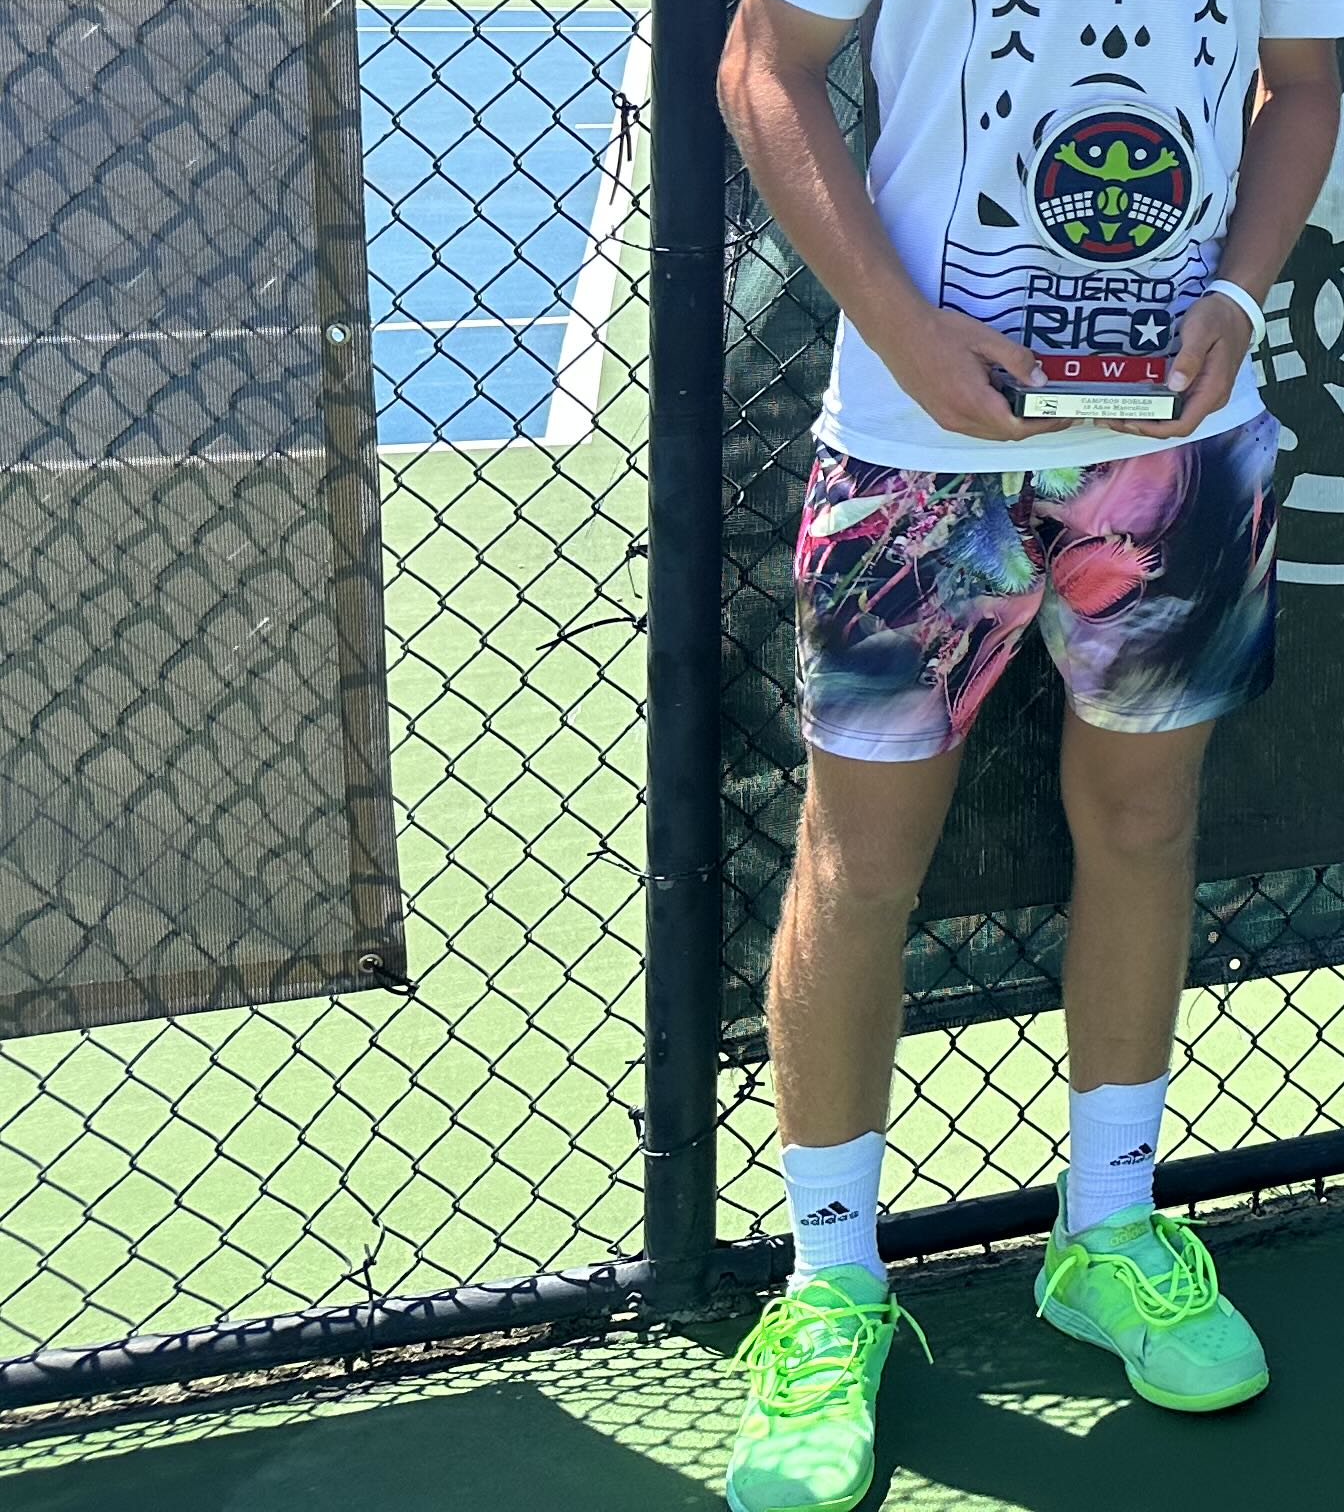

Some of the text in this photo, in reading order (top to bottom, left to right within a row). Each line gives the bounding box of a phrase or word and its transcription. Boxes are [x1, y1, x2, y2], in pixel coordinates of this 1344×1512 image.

[1027, 274, 1176, 303] PUERTO
[1035, 359, 1159, 379] OWL
[800, 1210, 860, 1226] adidas
